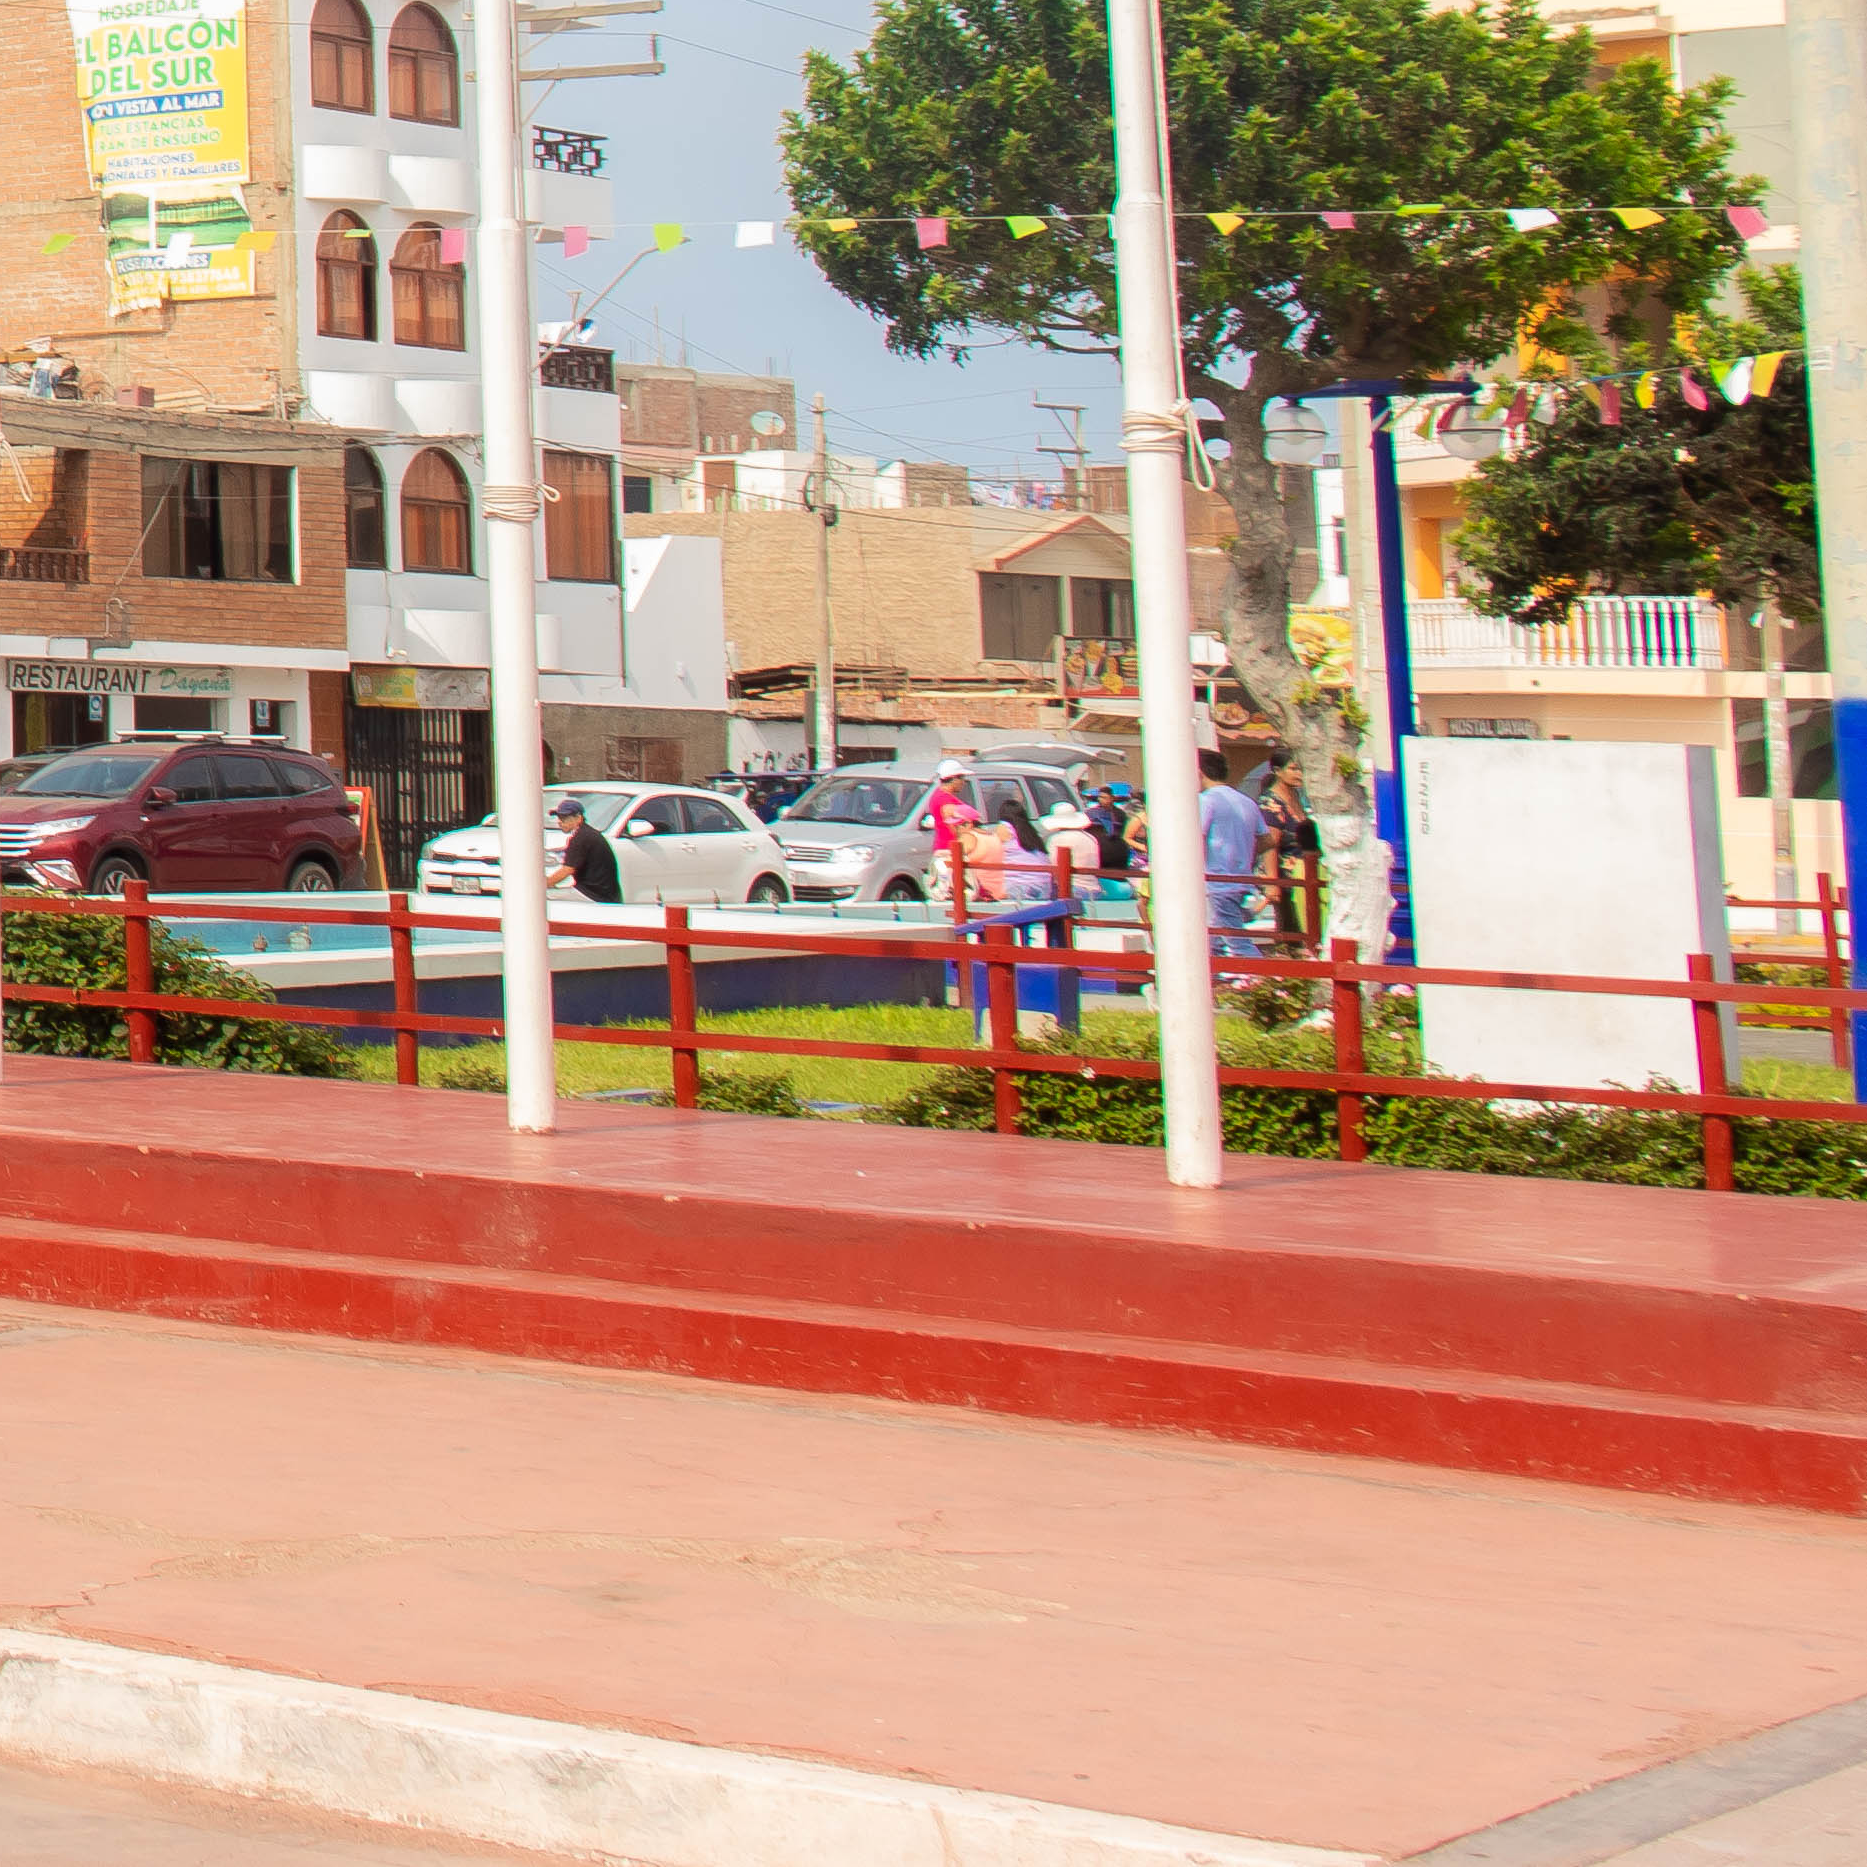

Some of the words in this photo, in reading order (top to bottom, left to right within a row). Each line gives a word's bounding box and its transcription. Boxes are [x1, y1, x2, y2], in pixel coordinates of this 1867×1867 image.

[107, 13, 238, 61] BALCÓN
[91, 64, 141, 96] DEL
[151, 56, 214, 88] SUR
[115, 98, 159, 116] VISTA
[160, 95, 183, 112] AL
[184, 91, 220, 110] MAR
[126, 115, 206, 134] ESTANCIAS
[172, 161, 242, 177] FAMILIARES
[13, 663, 152, 694] RESTAURANT
